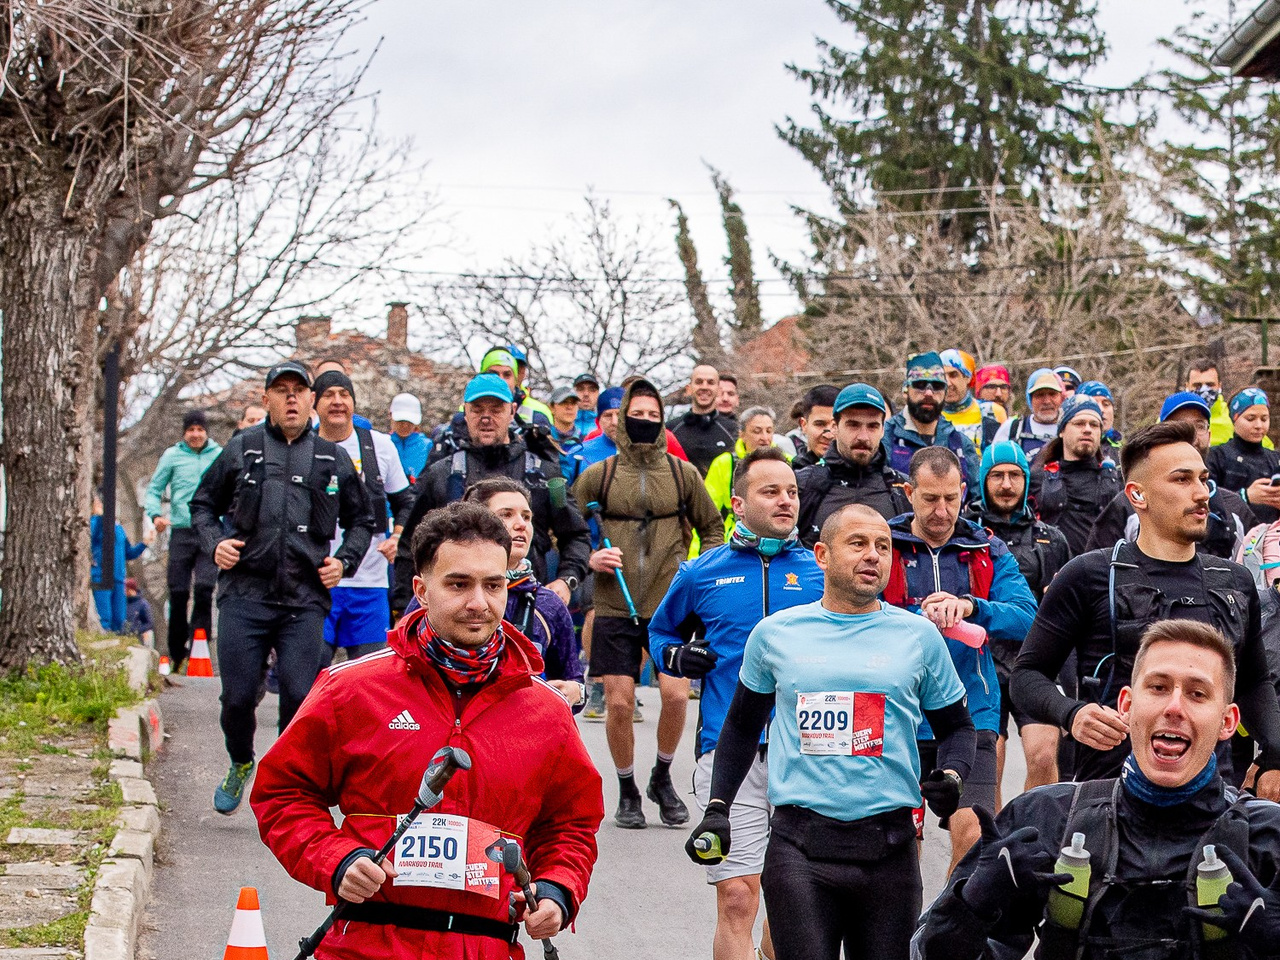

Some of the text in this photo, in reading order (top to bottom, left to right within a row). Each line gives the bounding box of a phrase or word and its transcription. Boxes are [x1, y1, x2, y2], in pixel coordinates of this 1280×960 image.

[715, 576, 746, 586] TRIMTEX
[799, 710, 848, 731] 2209
[388, 722, 420, 730] adidas
[432, 817, 446, 826] 22K
[401, 836, 458, 860] 2150
[398, 860, 443, 869] MARKOVO TRAIL
[466, 870, 485, 879] STEP
